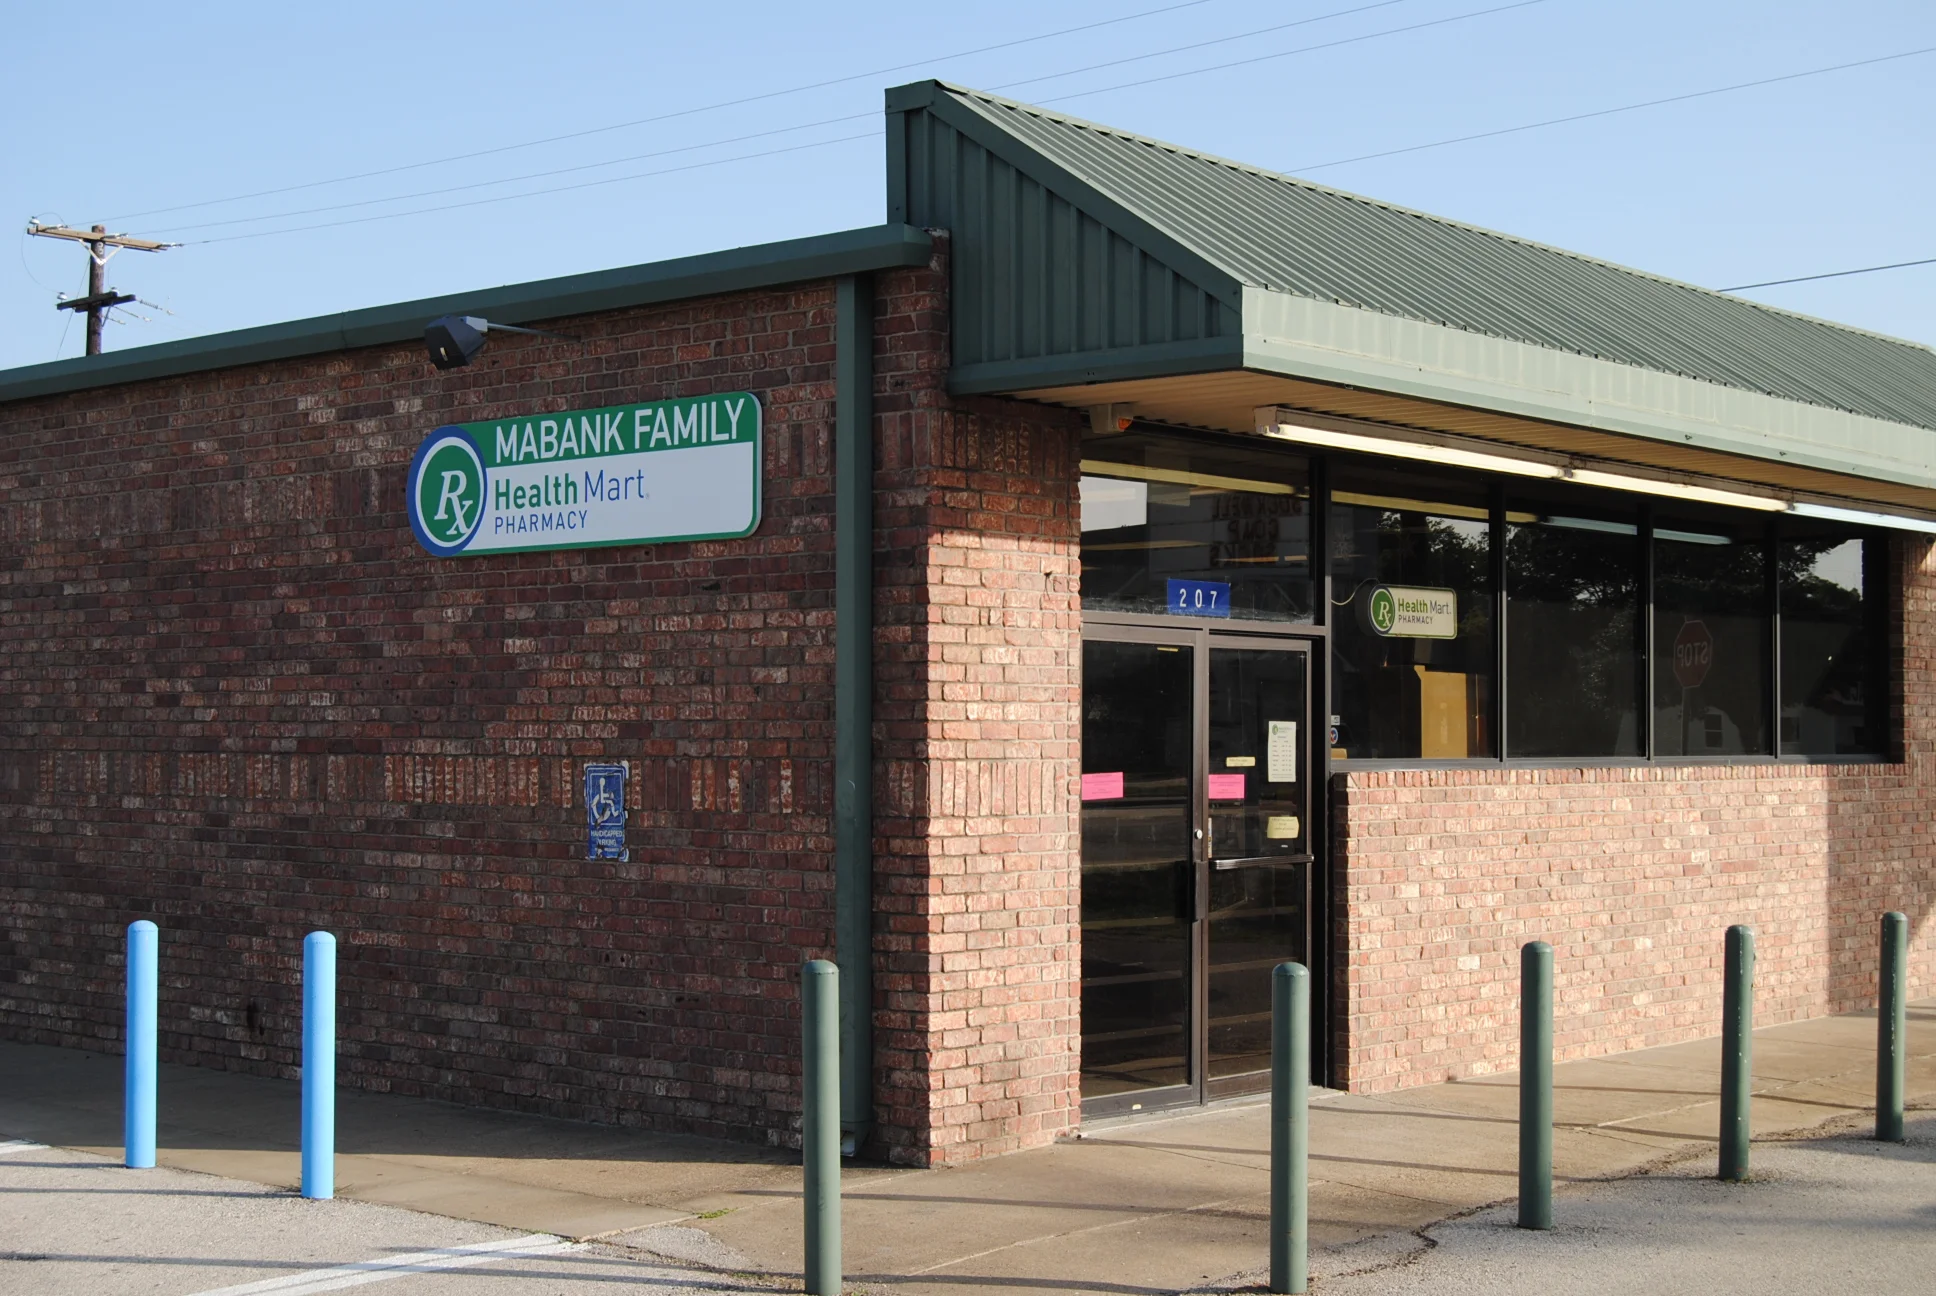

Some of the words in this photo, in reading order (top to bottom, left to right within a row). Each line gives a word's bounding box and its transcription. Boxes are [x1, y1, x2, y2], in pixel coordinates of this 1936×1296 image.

[496, 411, 625, 463] MABANK
[634, 398, 745, 450] FAMILY
[495, 473, 578, 511] Health
[495, 509, 587, 535] PHARMACY
[1180, 588, 1217, 609] 207
[1398, 598, 1428, 614] Health
[1398, 614, 1433, 625] PHARMACY
